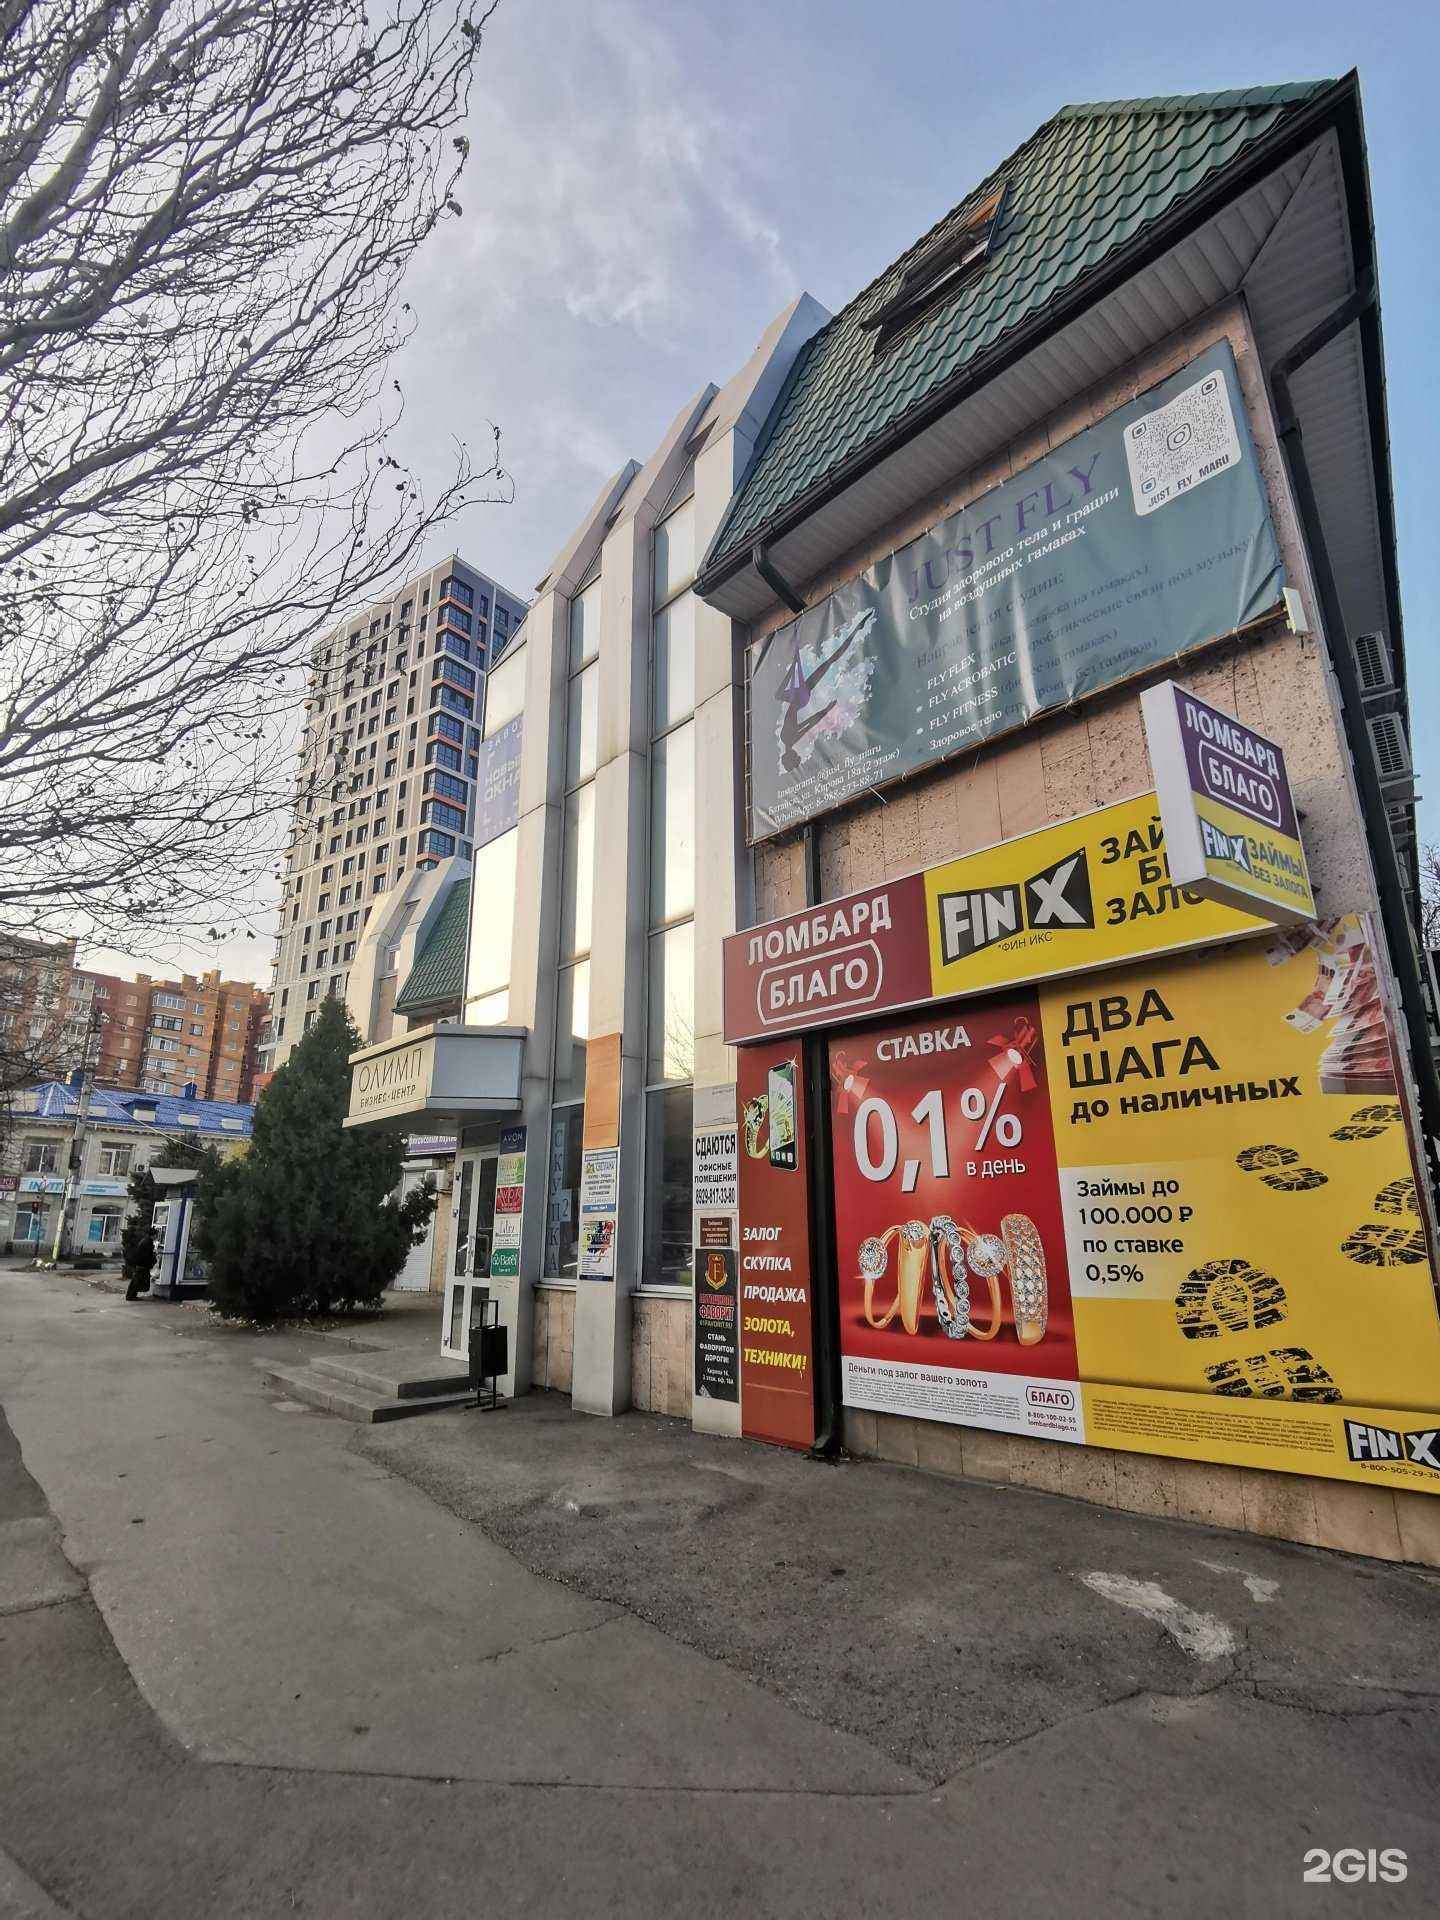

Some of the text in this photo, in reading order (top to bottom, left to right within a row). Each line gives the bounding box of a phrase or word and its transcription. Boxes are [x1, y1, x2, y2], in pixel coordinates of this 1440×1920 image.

[1148, 454, 1229, 507] JUST FLY MARU
[908, 452, 1102, 604] JUST FLY
[909, 487, 1120, 620] Студия здорового тела и грации
[938, 525, 1087, 624] на воздушных гамаках
[927, 653, 976, 690] FLY FLEX
[929, 690, 948, 708] FLY
[951, 652, 1017, 697] ACROBATIC
[930, 711, 951, 731] FLY
[953, 686, 999, 718] FITNESS
[929, 723, 979, 751] Здоровое
[979, 710, 1003, 727] тело
[1185, 702, 1280, 780] ЛОМБАРД
[777, 775, 815, 799] Instagram:
[814, 775, 844, 794] Кирова
[1208, 757, 1273, 811] БЛАГО
[1100, 816, 1164, 864] ЗАЙ
[1248, 838, 1307, 879] ЗАЙМЫ
[1251, 864, 1272, 884] БЕЗ
[943, 891, 1017, 959] FIN
[1029, 856, 1087, 924] X
[748, 894, 892, 965] ЛОМБАРД
[1030, 932, 1053, 945] ИКС
[770, 958, 868, 1010] БЛАГО
[1062, 988, 1174, 1046] ДВА
[876, 1024, 971, 1061] СТАВКА
[359, 1047, 422, 1092] ОЛИМП
[1066, 1036, 1220, 1088] ШАГА
[1071, 1076, 1302, 1124] до наличных
[503, 1130, 523, 1142] AVON
[695, 1134, 736, 1159] СДАЮТСЯ
[854, 1083, 1022, 1192] 0,1%
[694, 1173, 737, 1184] ПОМЕЩЕНИЯ
[699, 1162, 732, 1172] ОФИСНЫЕ
[966, 1158, 1026, 1178] в день
[1077, 1178, 1180, 1197] Займы до
[1079, 1206, 1172, 1224] 100.000
[743, 1227, 782, 1241] ЗАЛОГ
[1083, 1238, 1184, 1253] по ставке
[743, 1256, 792, 1271] СКУПКА
[1086, 1264, 1144, 1284] 0,5%
[744, 1285, 806, 1303] ПРОДАЖА
[699, 1305, 735, 1321] ФАВОРИТ
[707, 1333, 727, 1343] СТАНЬ
[744, 1317, 795, 1337] ЗОЛОТА,
[699, 1343, 735, 1354] ФАВОРИТОМ
[744, 1348, 807, 1370] ТЕХНИКИ!
[848, 1362, 988, 1389] Деньги под залог вашего золота
[1031, 1391, 1070, 1406] БЛАГО
[1028, 1419, 1077, 1433] lombardblago.ru
[1348, 1423, 1399, 1458] FIN
[1406, 1432, 1440, 1469] X
